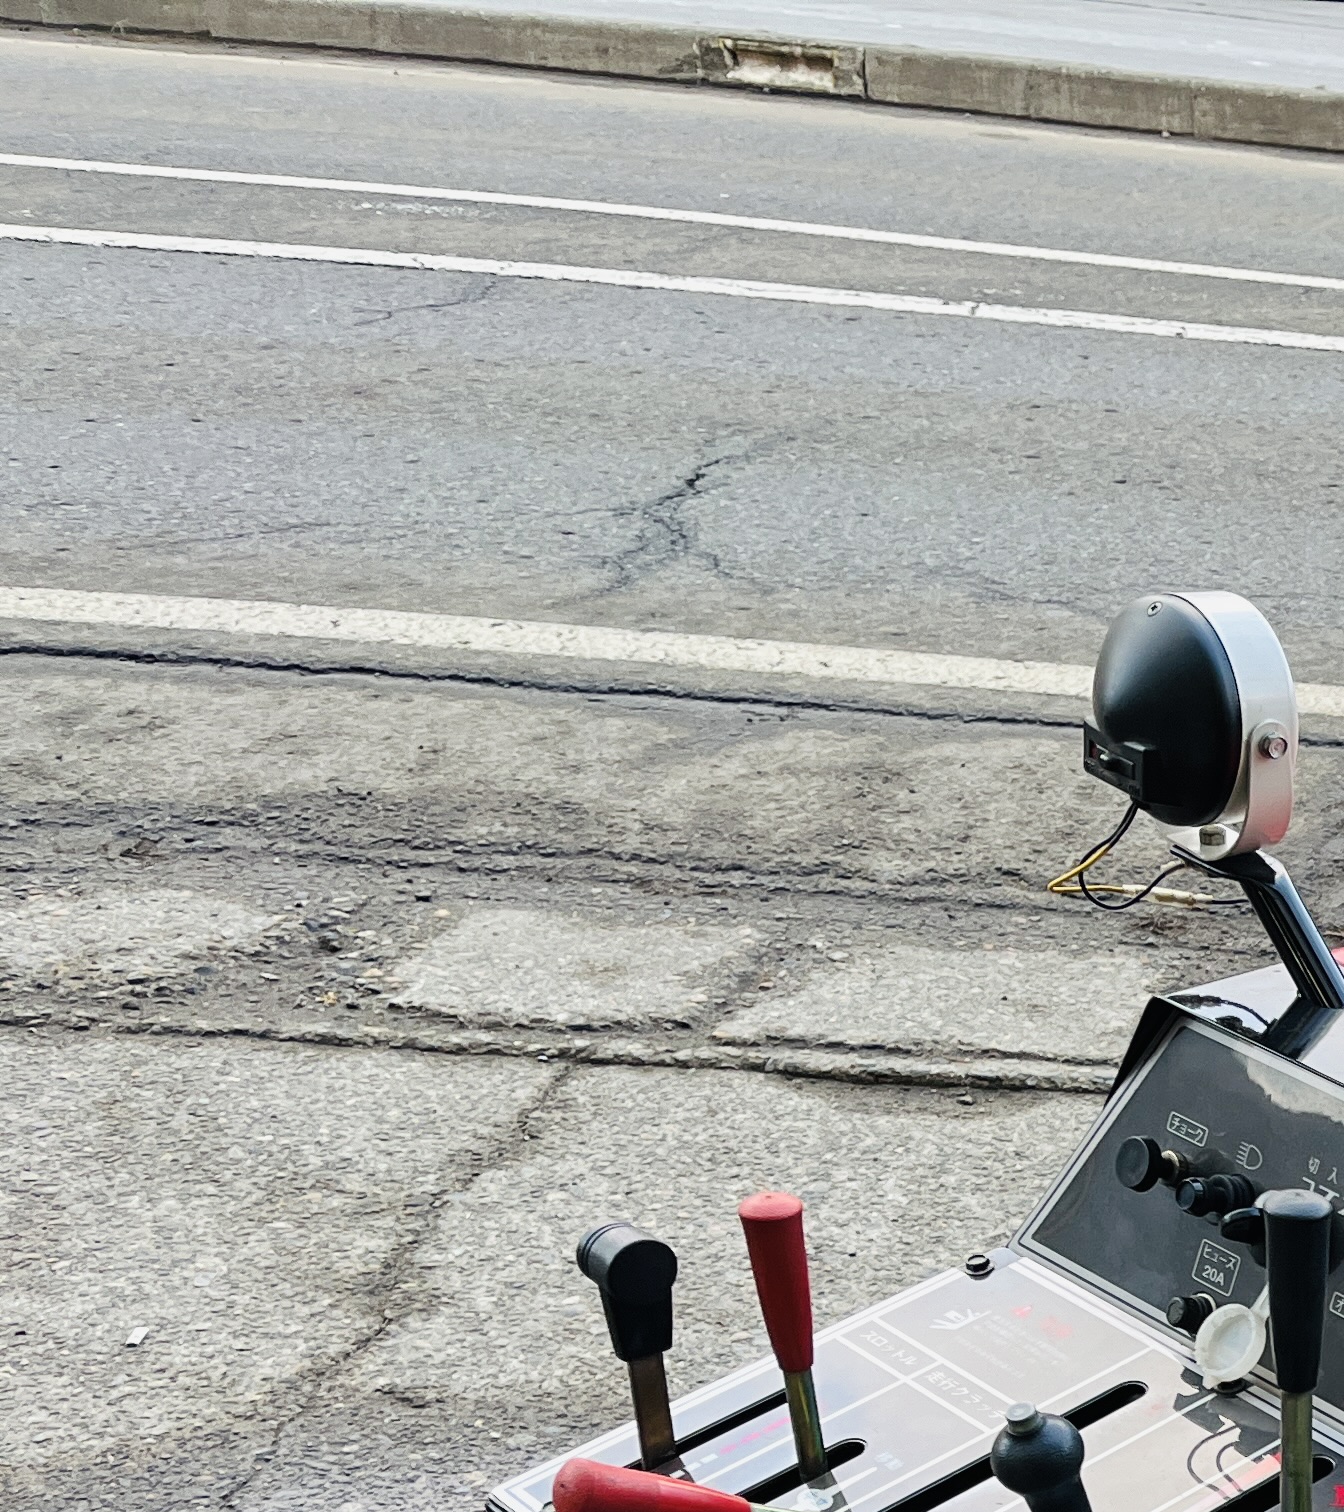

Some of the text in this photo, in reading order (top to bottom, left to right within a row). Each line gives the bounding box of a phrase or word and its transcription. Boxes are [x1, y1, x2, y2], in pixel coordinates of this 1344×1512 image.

[1170, 1116, 1204, 1147] チョーク
[1308, 1157, 1321, 1175] 切
[1326, 1167, 1339, 1185] 入
[1202, 1265, 1225, 1287] 20A
[858, 1330, 917, 1367] スロットル
